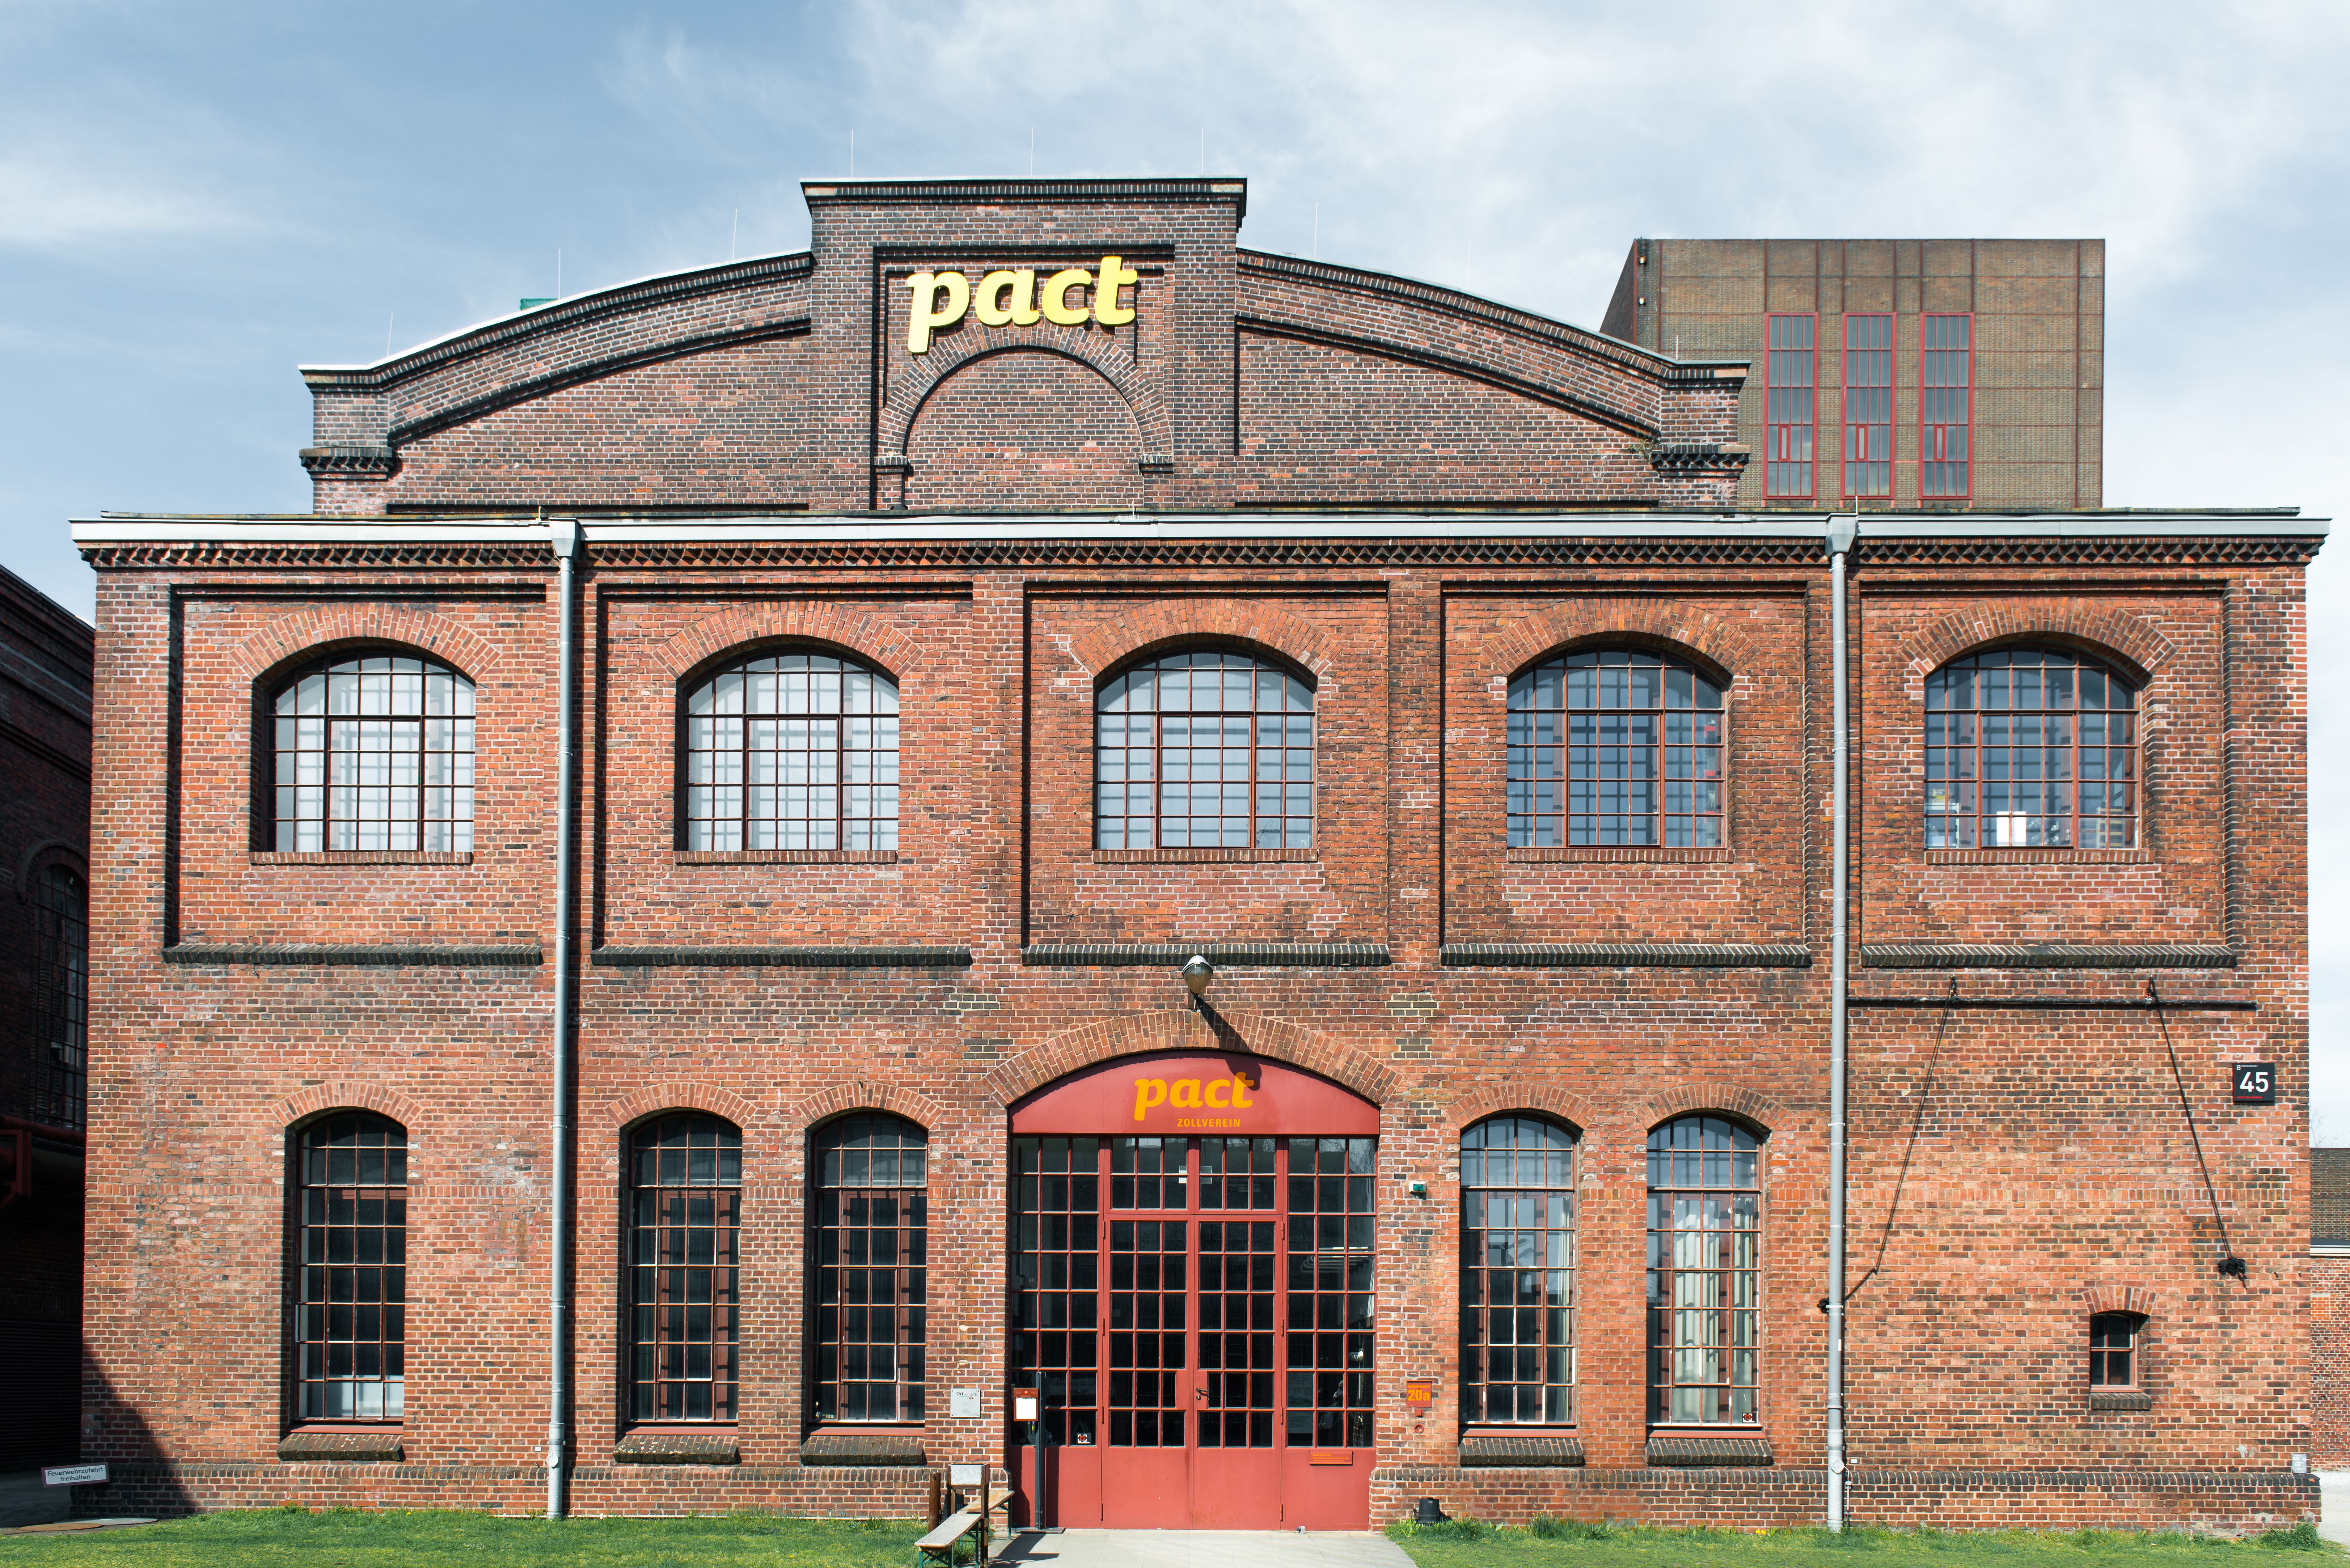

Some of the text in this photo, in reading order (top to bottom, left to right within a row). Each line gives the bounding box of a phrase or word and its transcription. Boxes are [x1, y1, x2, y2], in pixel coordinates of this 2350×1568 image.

[906, 256, 1138, 353] pact
[2240, 1072, 2269, 1092] 45
[1134, 1072, 1254, 1121] pact
[1177, 1118, 1240, 1127] ZOLLVEREIN
[1408, 1389, 1430, 1401] 20a
[48, 1467, 103, 1476] Feuerwehrzufahrt
